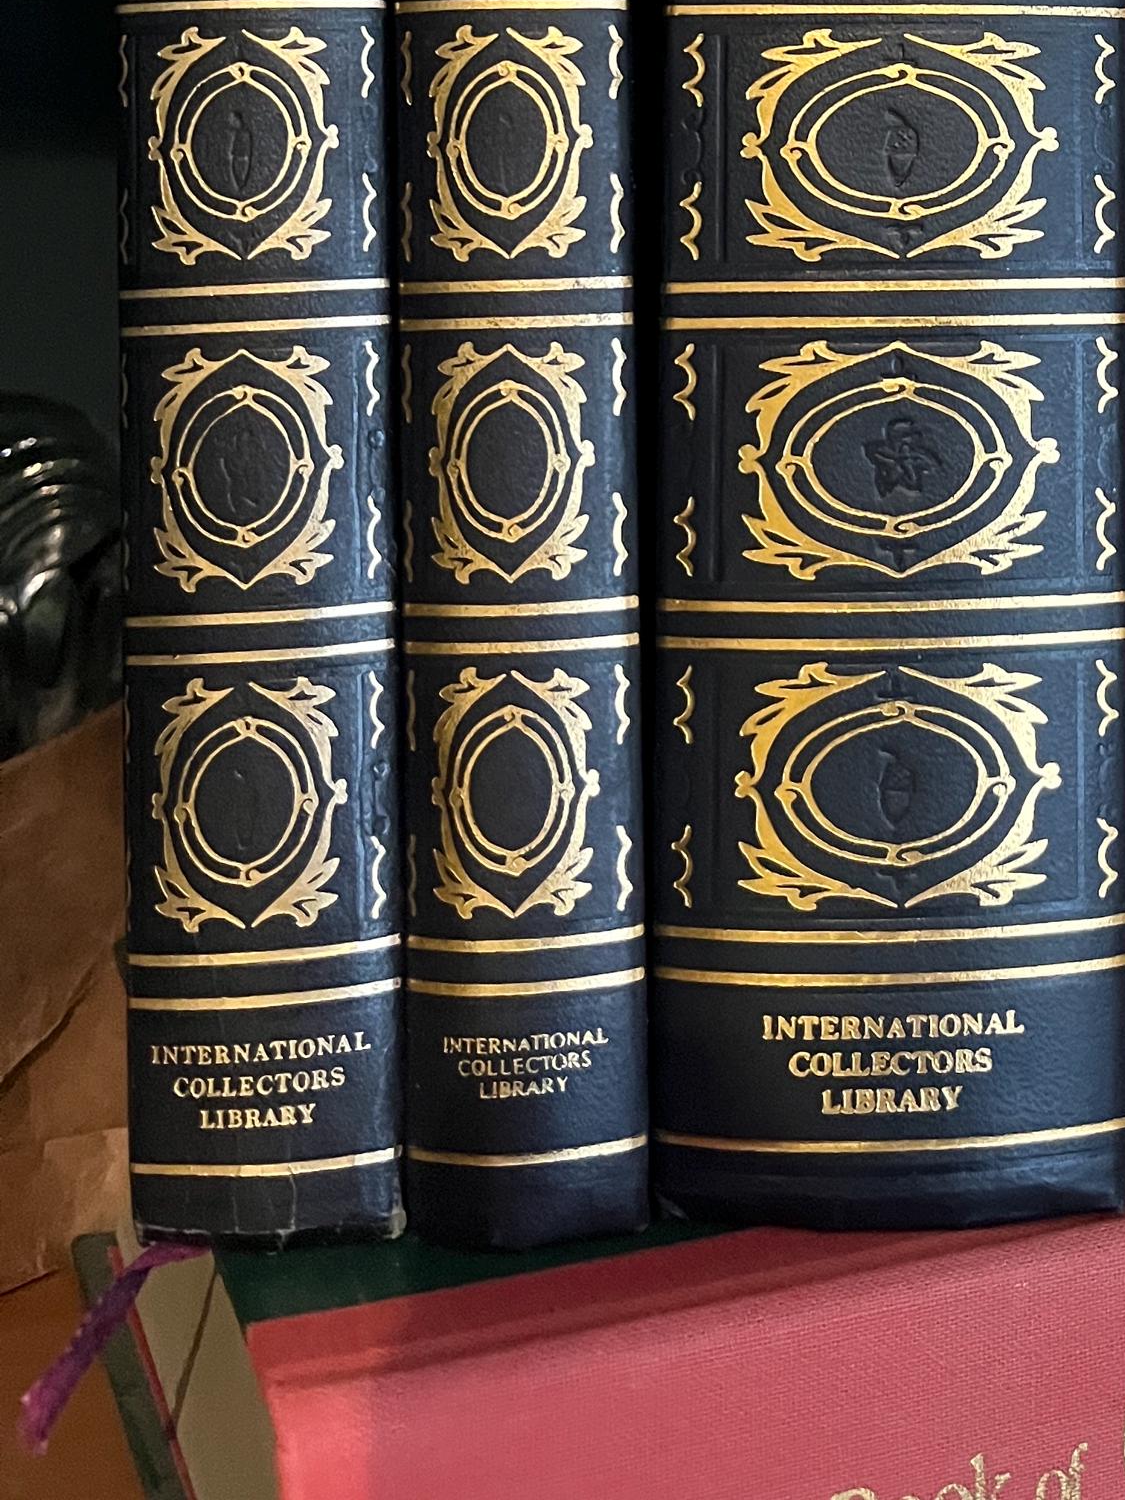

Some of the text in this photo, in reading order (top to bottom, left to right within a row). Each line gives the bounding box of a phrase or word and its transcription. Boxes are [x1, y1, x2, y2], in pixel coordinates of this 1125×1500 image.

[761, 1009, 1025, 1041] INTERNATIONAL
[151, 1031, 372, 1066] INTERNATIONAL
[443, 1027, 609, 1055] INTERNATIONAL
[458, 1051, 593, 1078] COLLECTORS
[788, 1047, 993, 1078] COLLECTORS
[173, 1067, 346, 1100] COLLECTORS
[479, 1076, 569, 1100] LIBRARY
[821, 1085, 964, 1115] LIBRARY
[200, 1103, 317, 1130] LIBRARY
